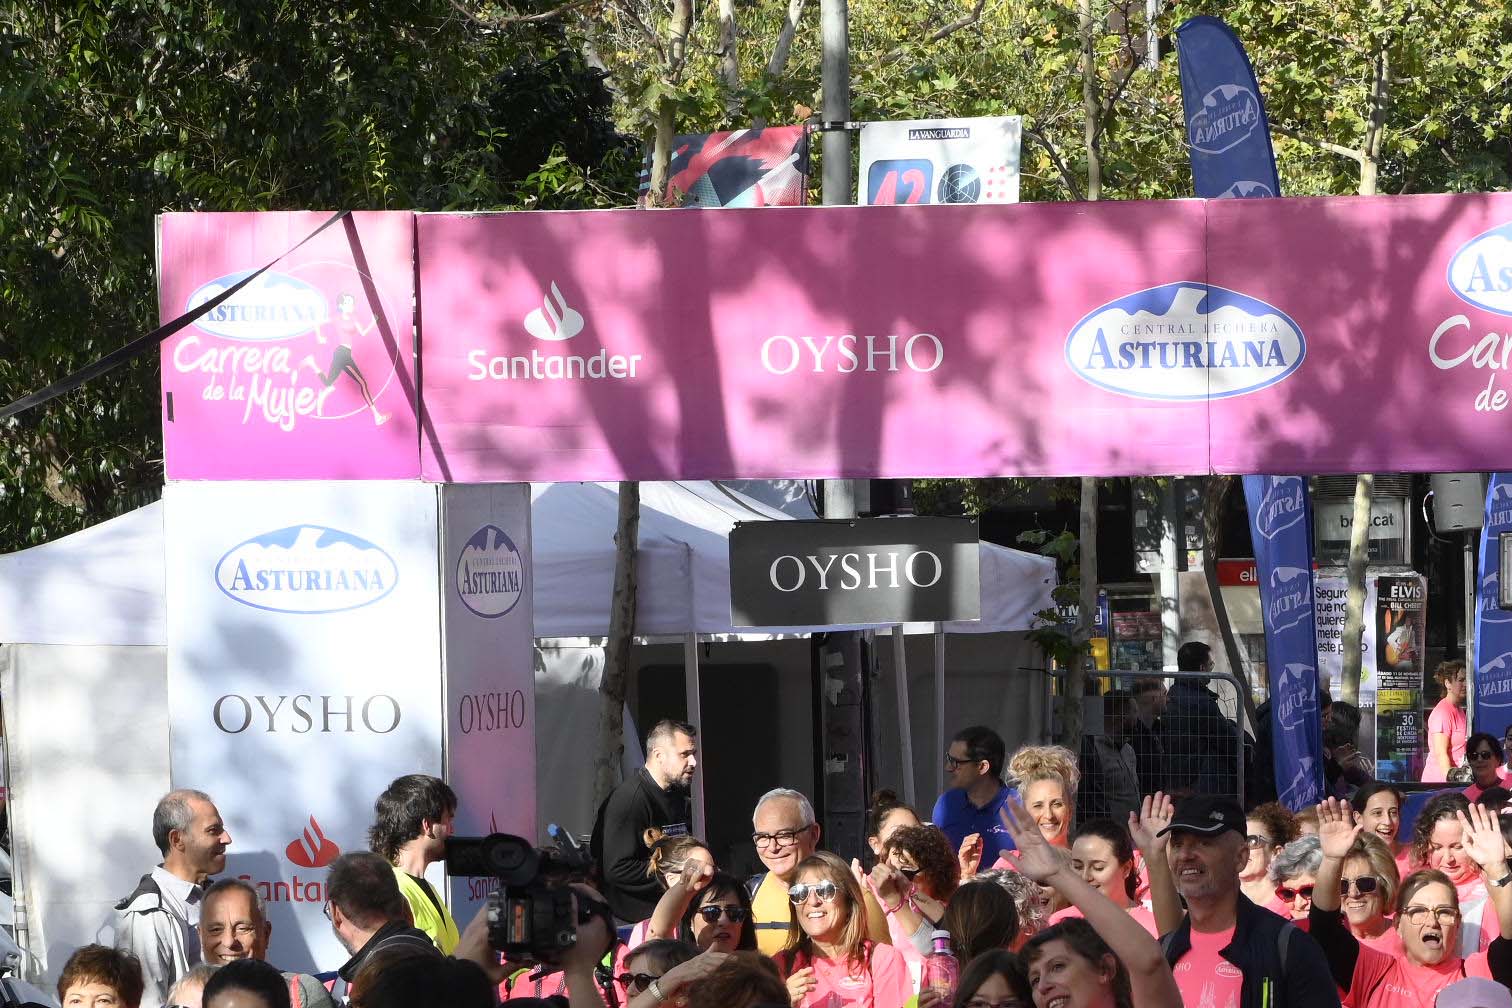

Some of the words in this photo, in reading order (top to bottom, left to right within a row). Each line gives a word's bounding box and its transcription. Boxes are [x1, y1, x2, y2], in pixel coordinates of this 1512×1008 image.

[1121, 322, 1193, 337] CENTRAL
[173, 336, 291, 373] Carrera
[467, 348, 641, 381] Santander
[761, 333, 944, 375] OYSHO
[1083, 327, 1288, 370] ASTURIANA
[203, 376, 223, 401] de
[229, 374, 244, 401] la
[242, 371, 335, 432] Mujer
[1475, 373, 1508, 412] de
[230, 558, 384, 592] ASTURIANA
[462, 562, 519, 595] ASTURIANA
[769, 549, 943, 592] OYSHO
[1317, 602, 1332, 614] que
[1390, 585, 1421, 598] ELVIS
[1318, 642, 1336, 653] este
[212, 694, 401, 734] OYSHO
[458, 689, 525, 735] OYSHO
[1402, 715, 1413, 726] 30
